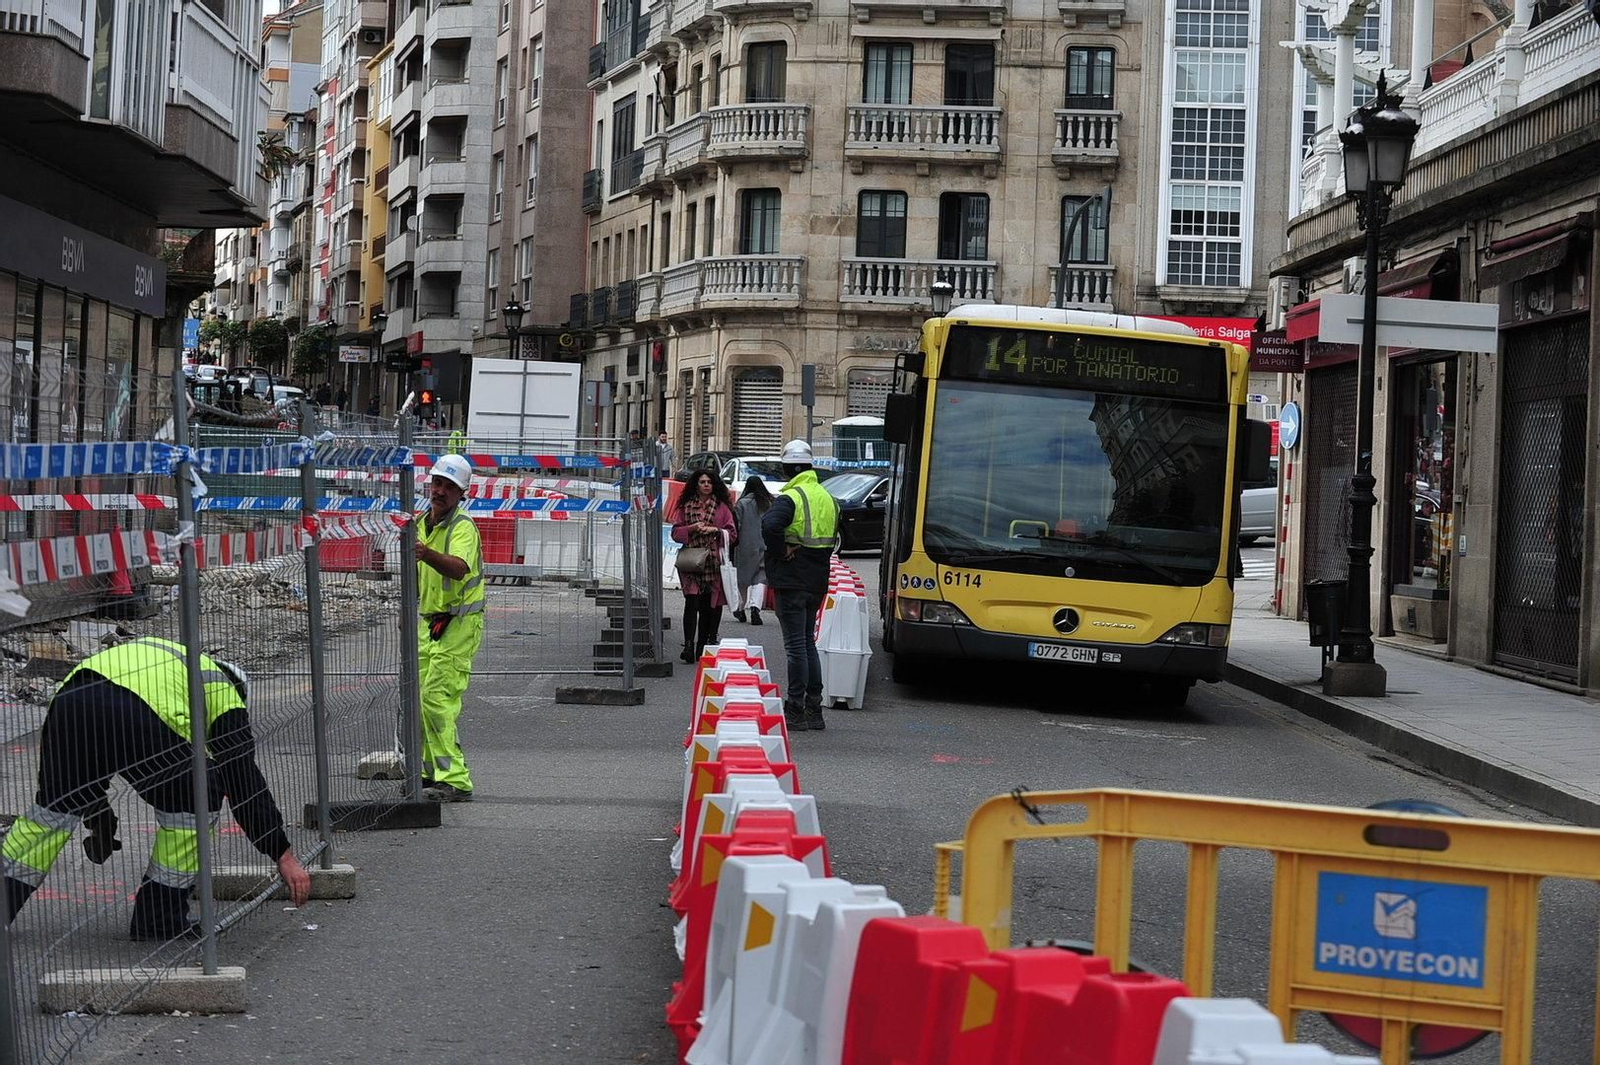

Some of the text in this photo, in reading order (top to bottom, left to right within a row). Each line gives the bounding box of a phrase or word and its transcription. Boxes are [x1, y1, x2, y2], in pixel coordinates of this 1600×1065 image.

[61, 236, 85, 275] BBVA
[134, 264, 154, 298] BBVA
[1218, 326, 1258, 340] Salga
[522, 350, 540, 358] DOS
[984, 333, 1027, 373] 14
[1256, 347, 1300, 355] MUNICIPAL
[1031, 357, 1179, 384] POR TANATORIO
[1259, 358, 1298, 367] DA PONTE
[943, 571, 982, 588] 6114
[1036, 645, 1096, 662] 0772 GHN
[1103, 653, 1122, 662] SP
[1319, 942, 1479, 979] PROYECON
